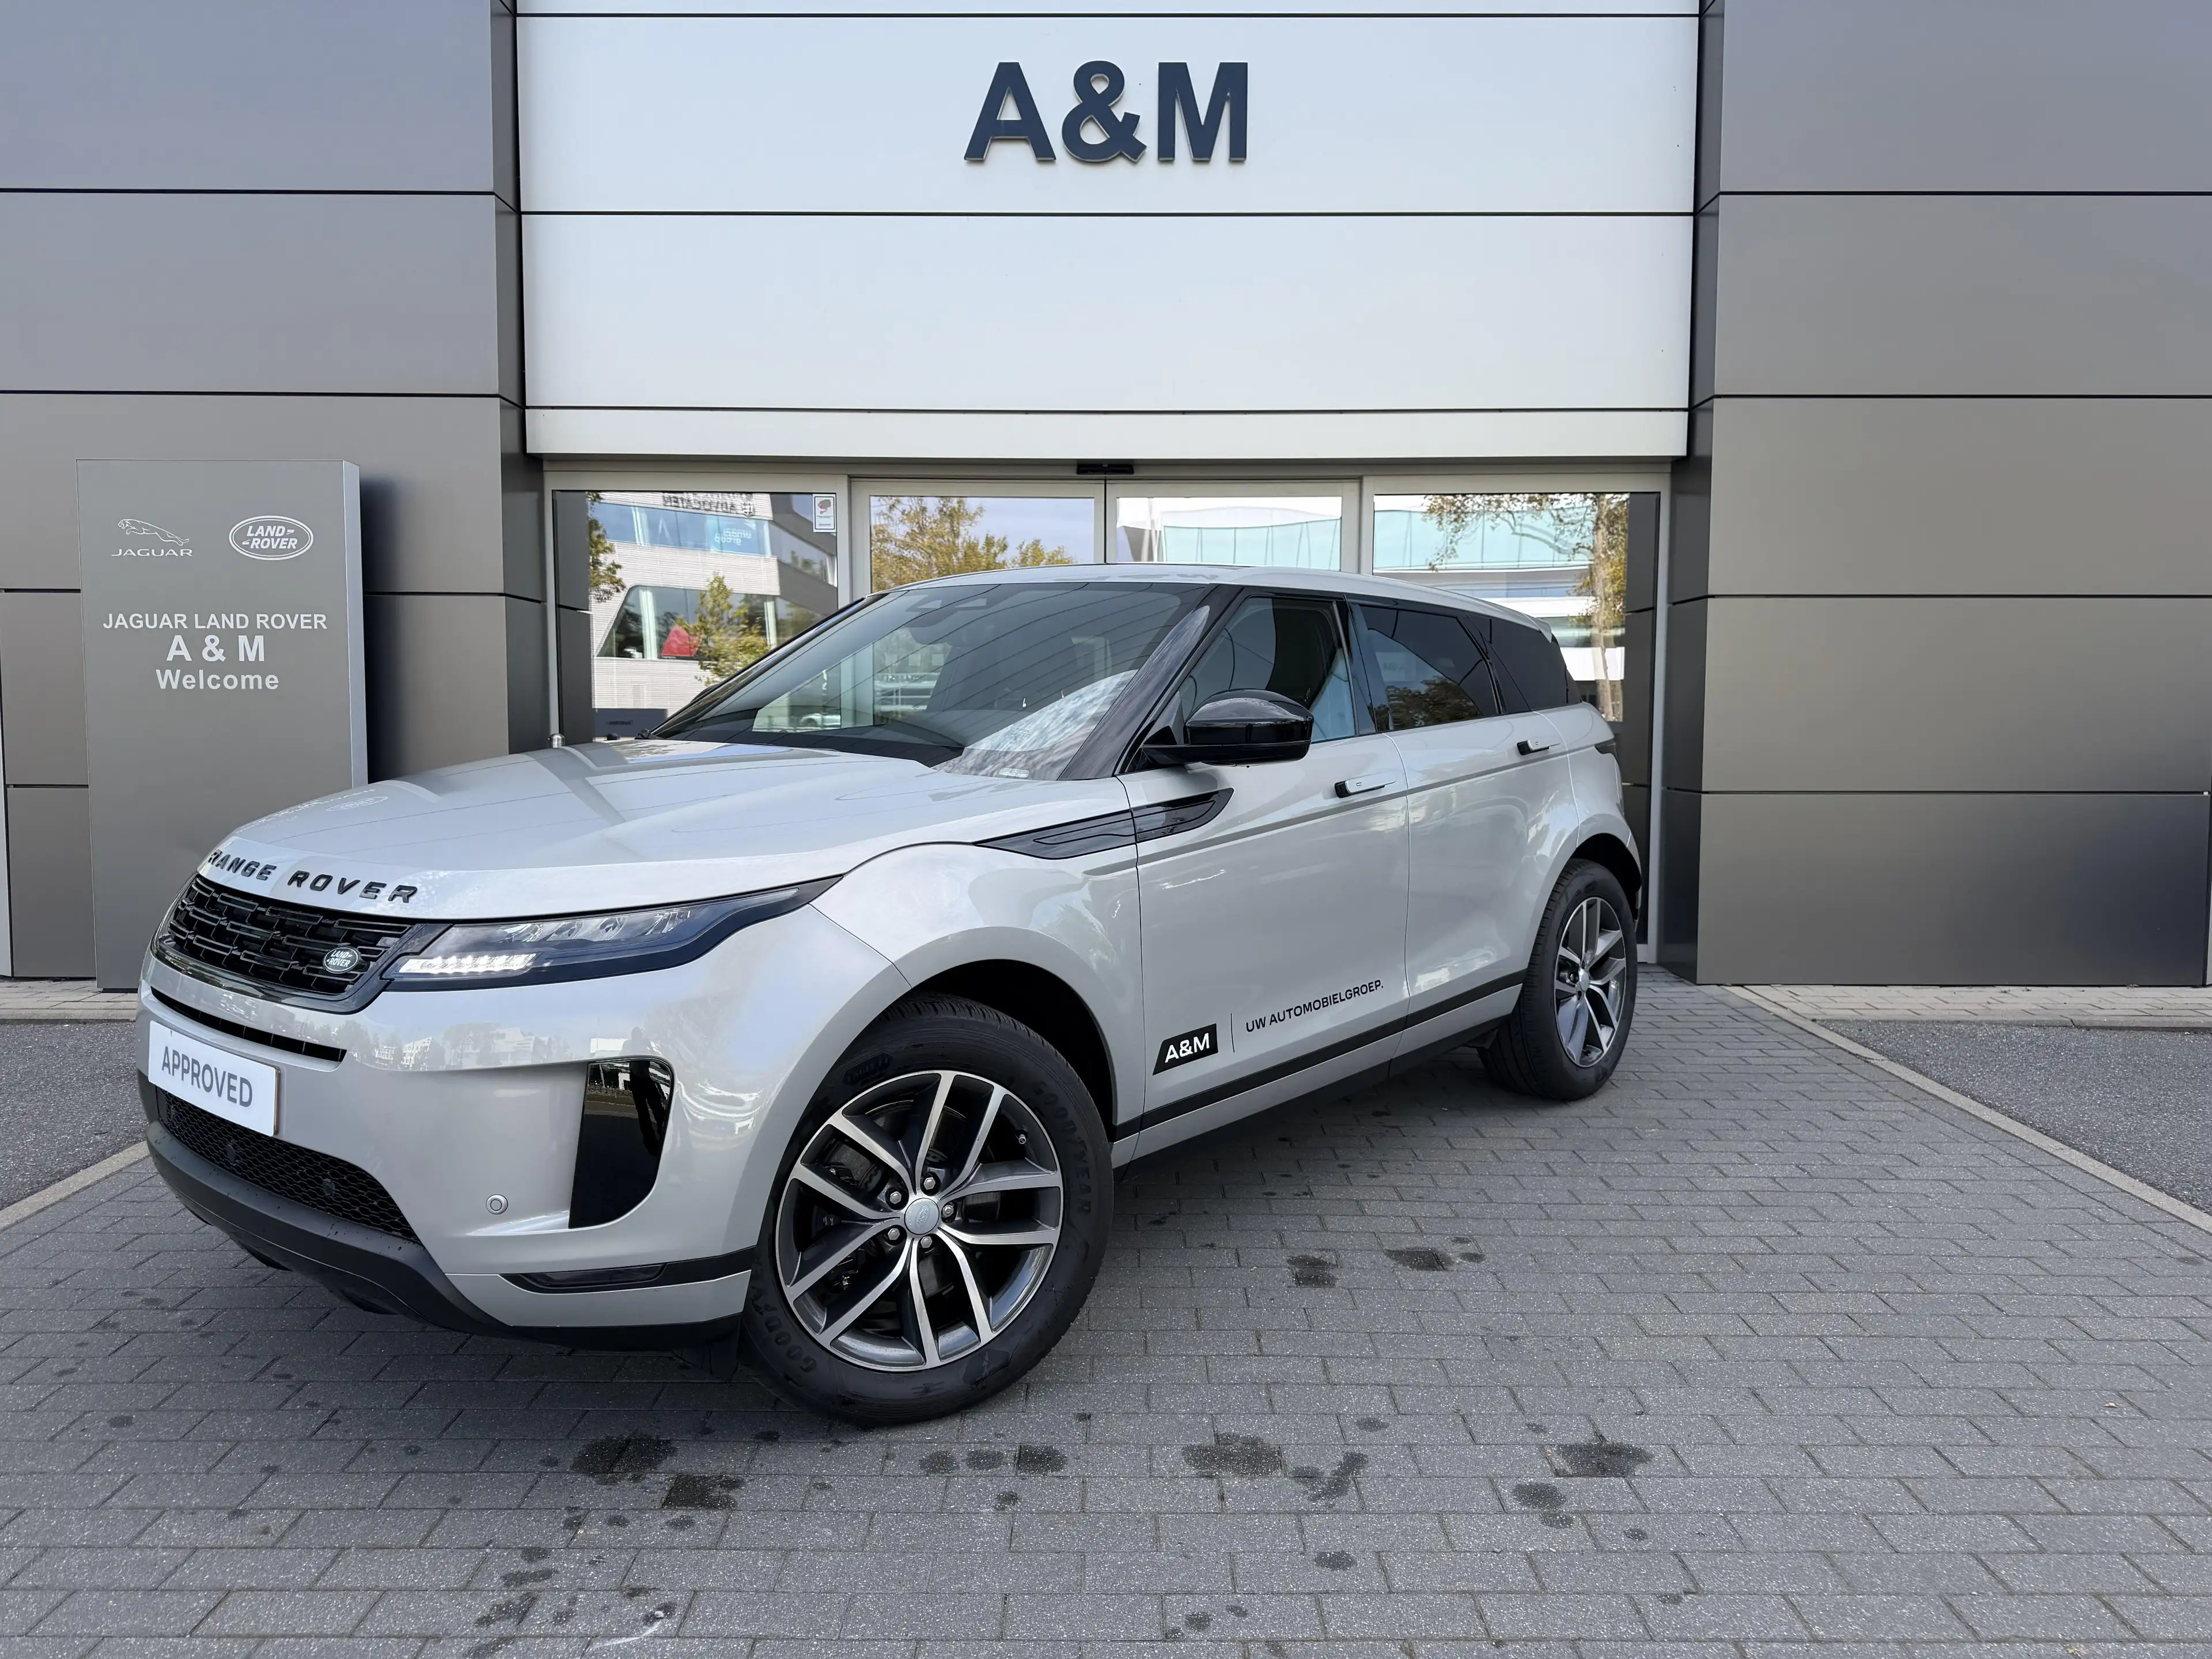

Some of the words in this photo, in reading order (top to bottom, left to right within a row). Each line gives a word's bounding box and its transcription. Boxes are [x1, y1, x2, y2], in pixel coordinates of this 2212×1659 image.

[964, 60, 1248, 162] A&M
[247, 525, 286, 537] LAND
[111, 548, 192, 557] JAGUAR
[250, 537, 298, 549] ROVER
[103, 613, 188, 629] JAGUAR
[195, 613, 249, 629] LAND
[257, 613, 327, 630] ROVER
[166, 635, 192, 662] A
[202, 635, 226, 662] &
[238, 635, 264, 662] M
[156, 669, 279, 690] Welcome
[207, 849, 277, 881] RANGE
[287, 870, 417, 904] ROVER
[328, 957, 351, 968] ROVER
[331, 950, 350, 959] LAND
[1165, 1032, 1210, 1063] A&M
[1245, 1016, 1267, 1032] UW
[1269, 979, 1384, 1026] AUTOMOBIELGROEP.
[161, 1046, 253, 1108] APPROVED
